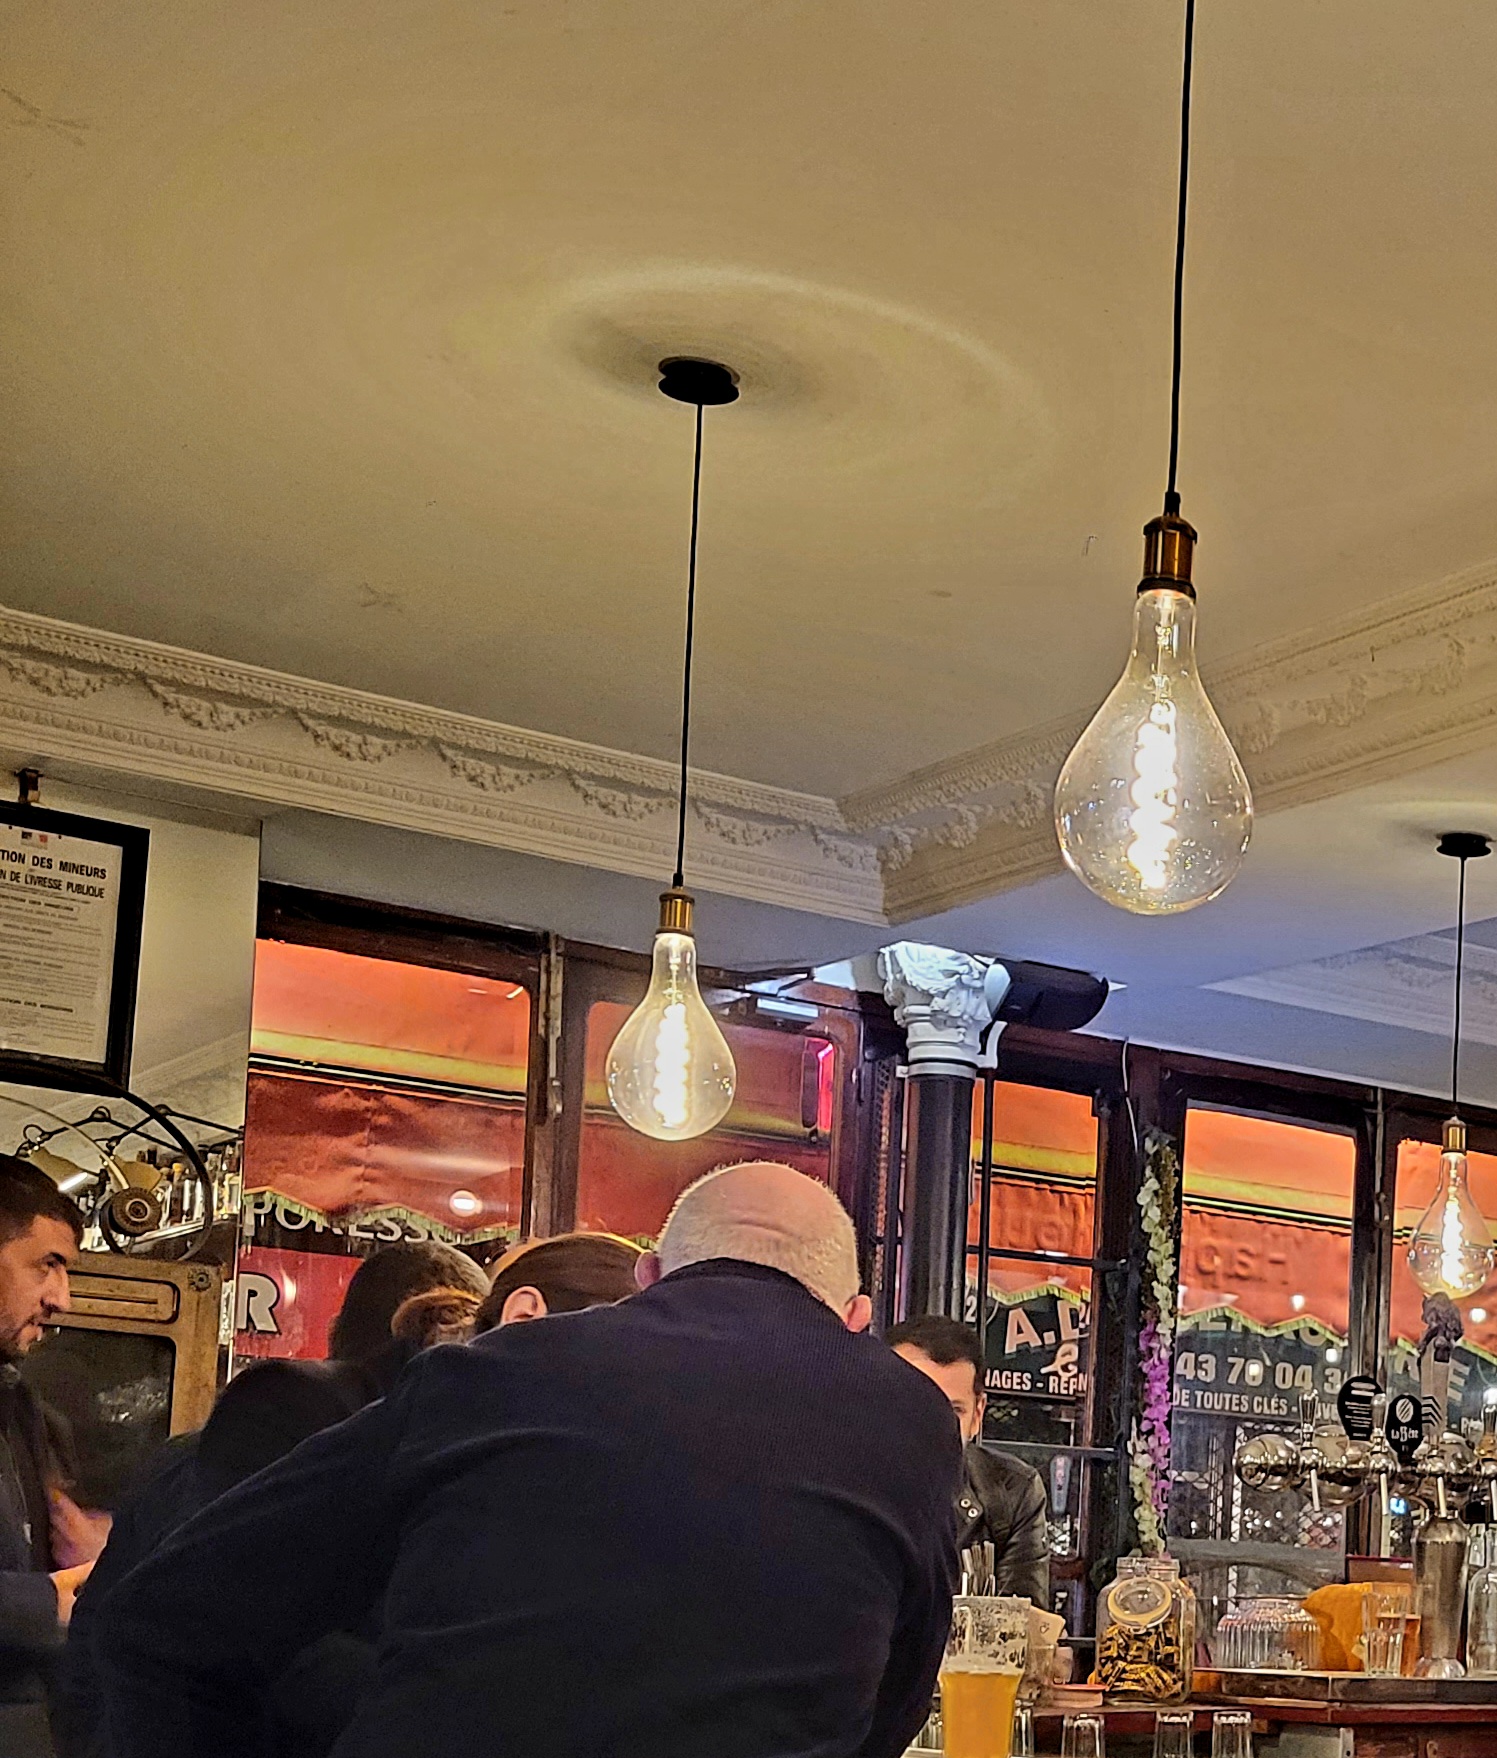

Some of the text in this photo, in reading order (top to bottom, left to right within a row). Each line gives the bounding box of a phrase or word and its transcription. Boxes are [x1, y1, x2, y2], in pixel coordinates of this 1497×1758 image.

[32, 855, 53, 869] DES
[59, 860, 107, 879] MINEURS
[10, 871, 21, 883] DE
[66, 881, 105, 899] PUBLIQUE
[1324, 1367, 1348, 1395] 3
[1194, 1390, 1250, 1413] TOUTES
[1253, 1393, 1288, 1416] CLÉS
